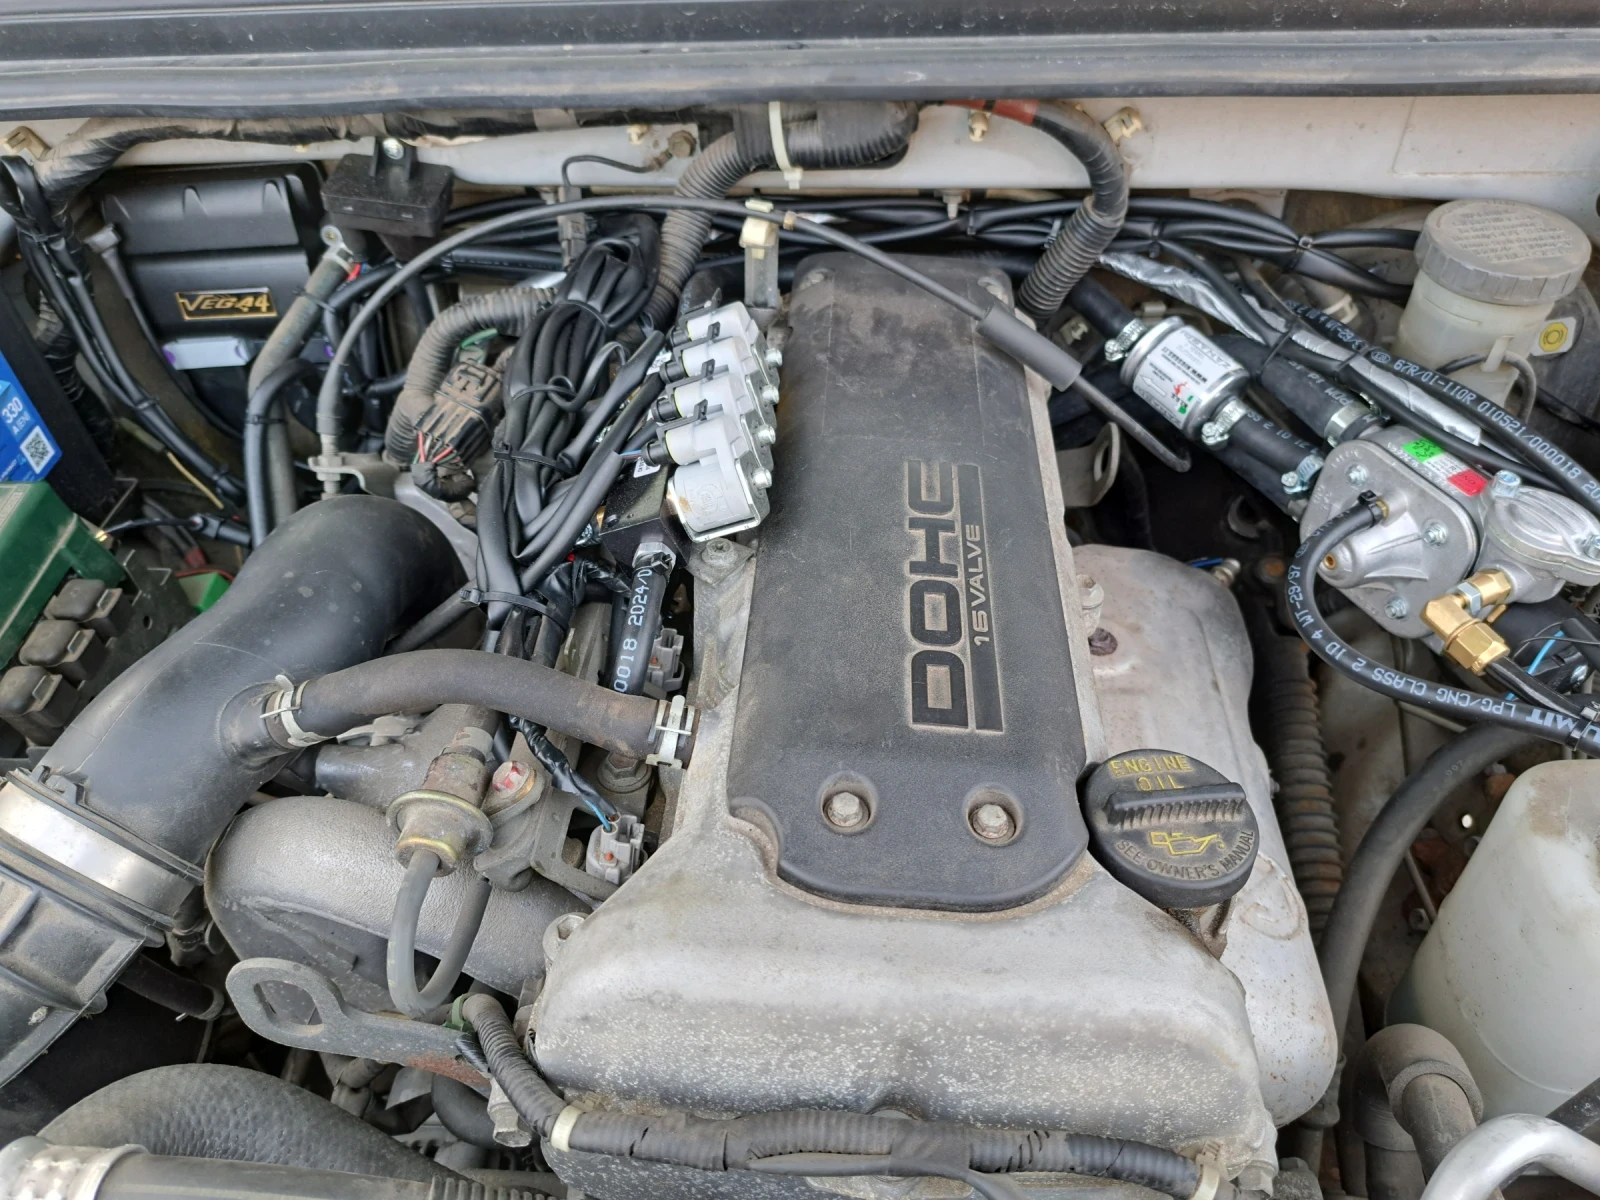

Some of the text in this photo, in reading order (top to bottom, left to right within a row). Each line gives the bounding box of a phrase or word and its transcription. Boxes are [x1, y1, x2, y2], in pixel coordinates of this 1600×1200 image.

[2, 397, 23, 424] 330
[1477, 401, 1581, 479] 010521/000018
[1581, 480, 1600, 505] 20
[907, 459, 969, 730] DOHC
[1311, 629, 1324, 640] 4
[1351, 657, 1367, 672] 2
[1371, 667, 1427, 696] CLASS
[1436, 687, 1516, 718] LPG/CNG
[1109, 754, 1192, 777] ENGINE
[1137, 774, 1185, 792] OIL
[1116, 830, 1254, 880] SEE OWNER'S MANUAL
